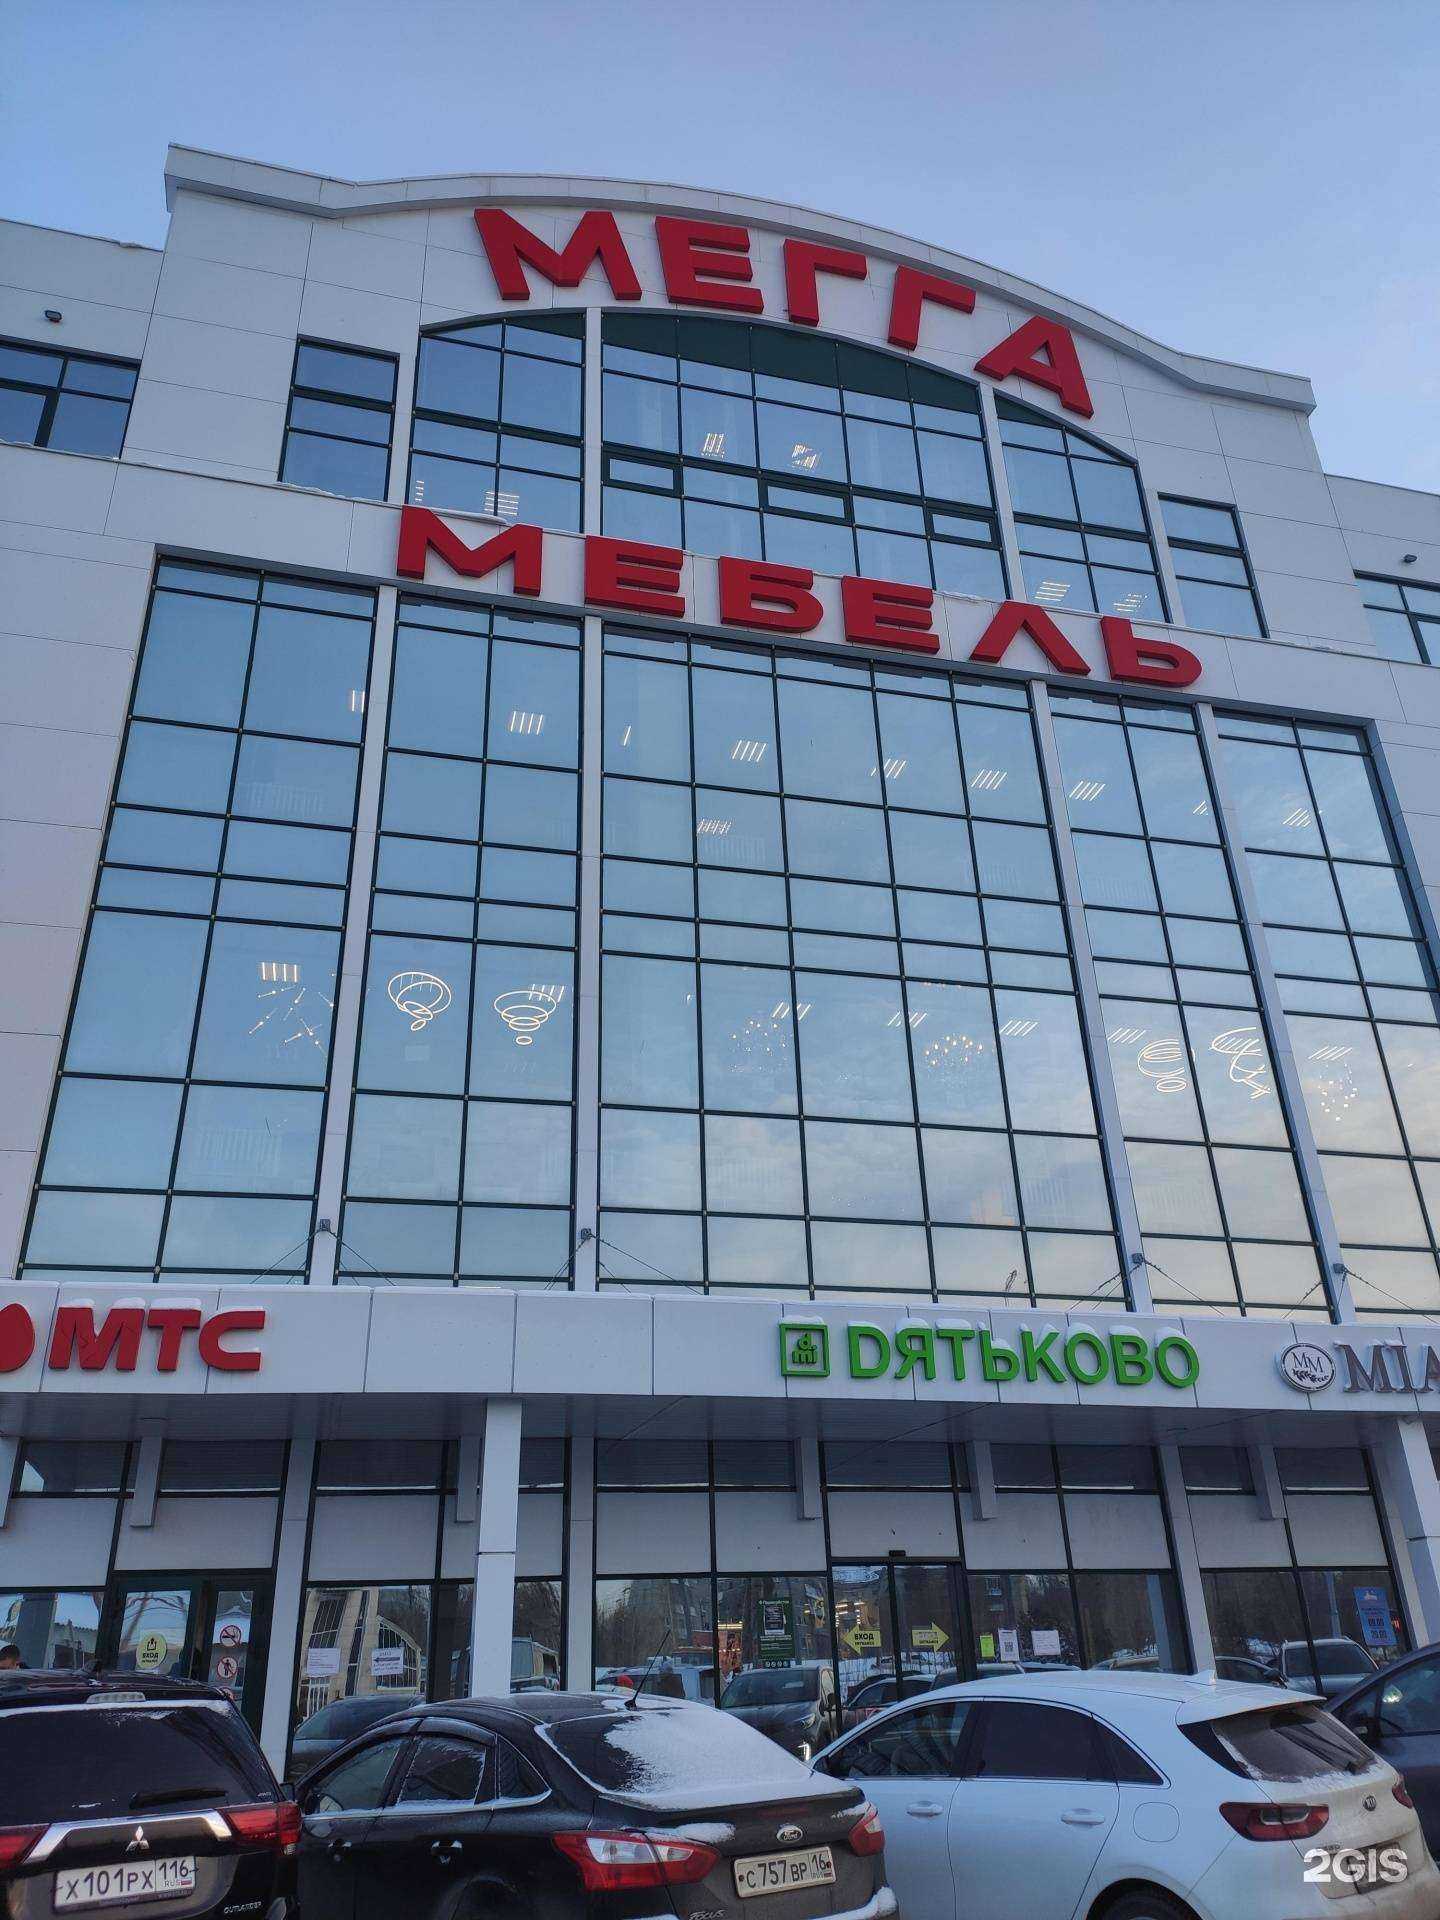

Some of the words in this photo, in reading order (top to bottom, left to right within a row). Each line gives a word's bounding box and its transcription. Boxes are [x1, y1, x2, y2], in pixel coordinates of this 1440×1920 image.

[474, 208, 1094, 418] МЕГГА
[396, 505, 1203, 687] МЕБЕЛЬ
[49, 1306, 266, 1371] МТС
[854, 1633, 874, 1641] ВХОД
[159, 1859, 189, 1880] 116
